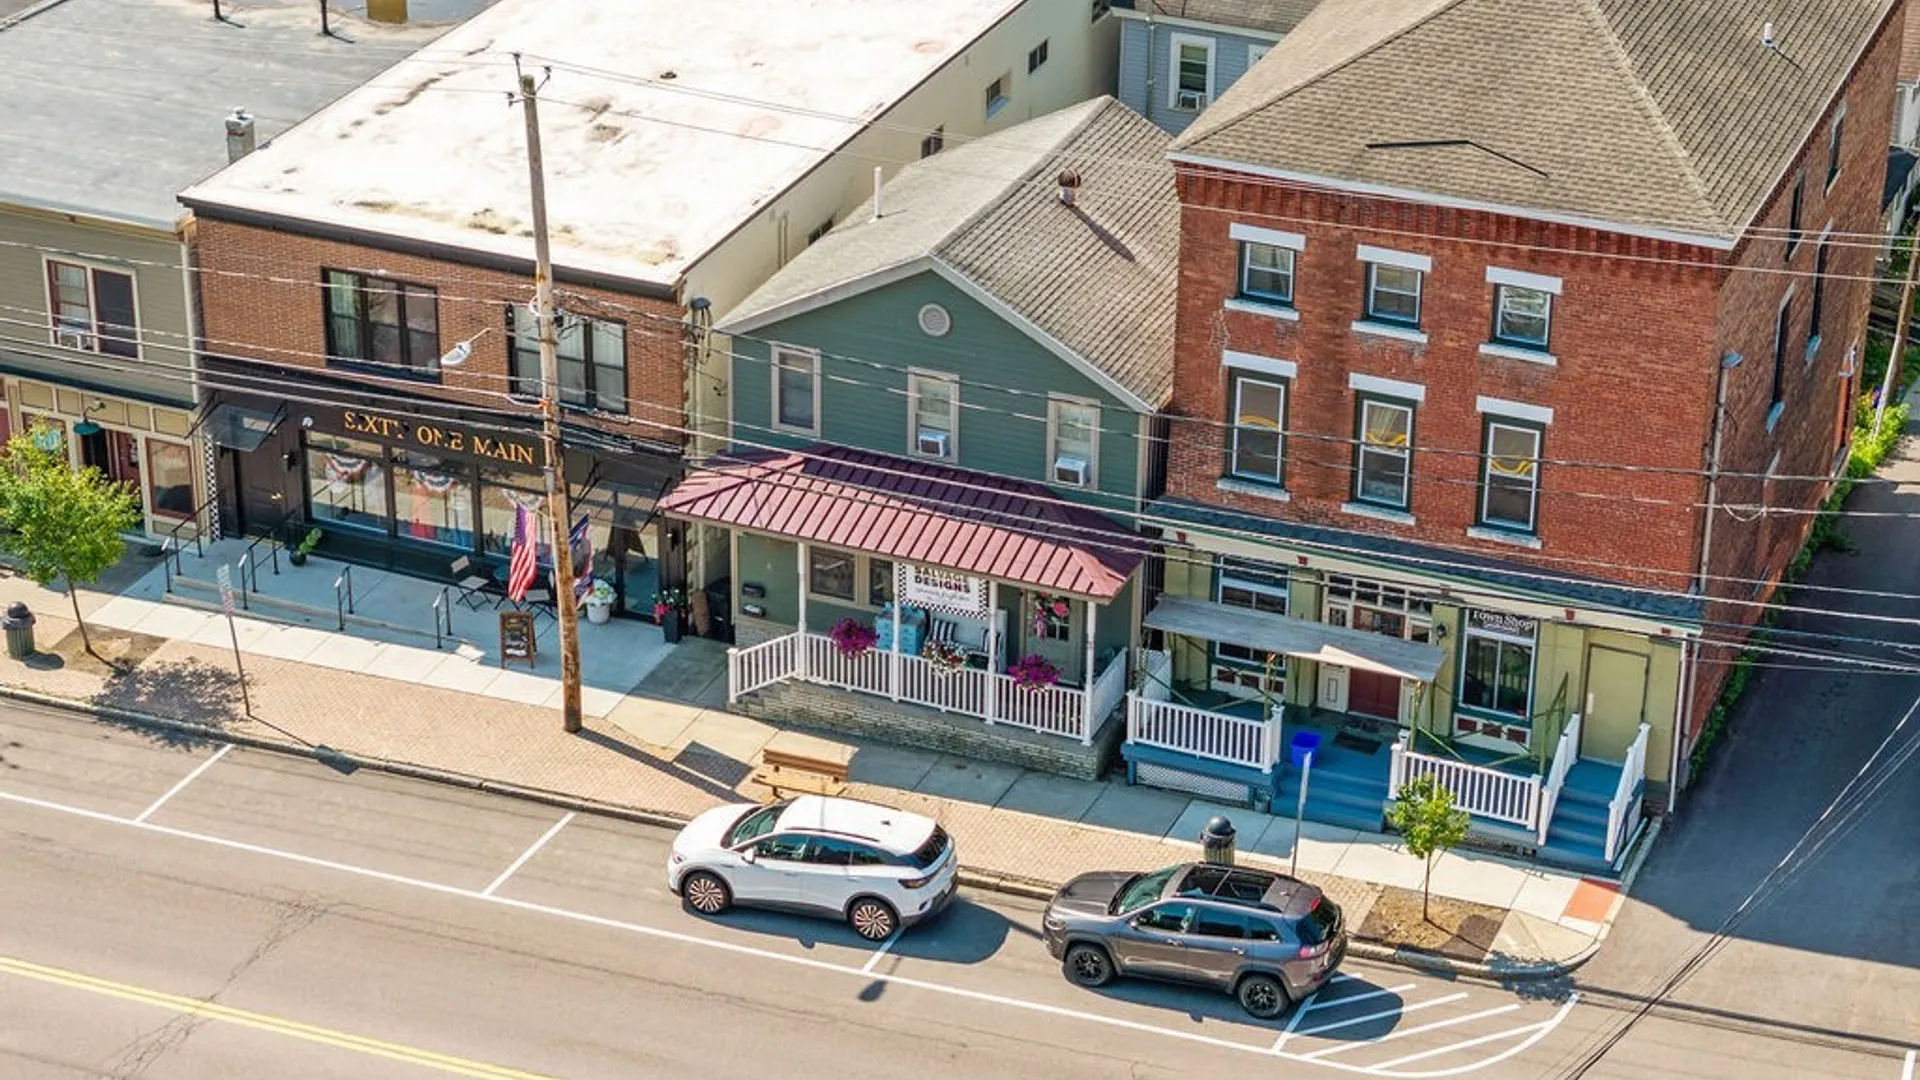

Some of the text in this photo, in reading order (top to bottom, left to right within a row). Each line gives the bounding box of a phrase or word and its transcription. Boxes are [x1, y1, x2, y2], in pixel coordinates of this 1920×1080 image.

[344, 411, 408, 440] SXT
[472, 436, 534, 465] MAIN
[914, 575, 971, 594] DESIGNS
